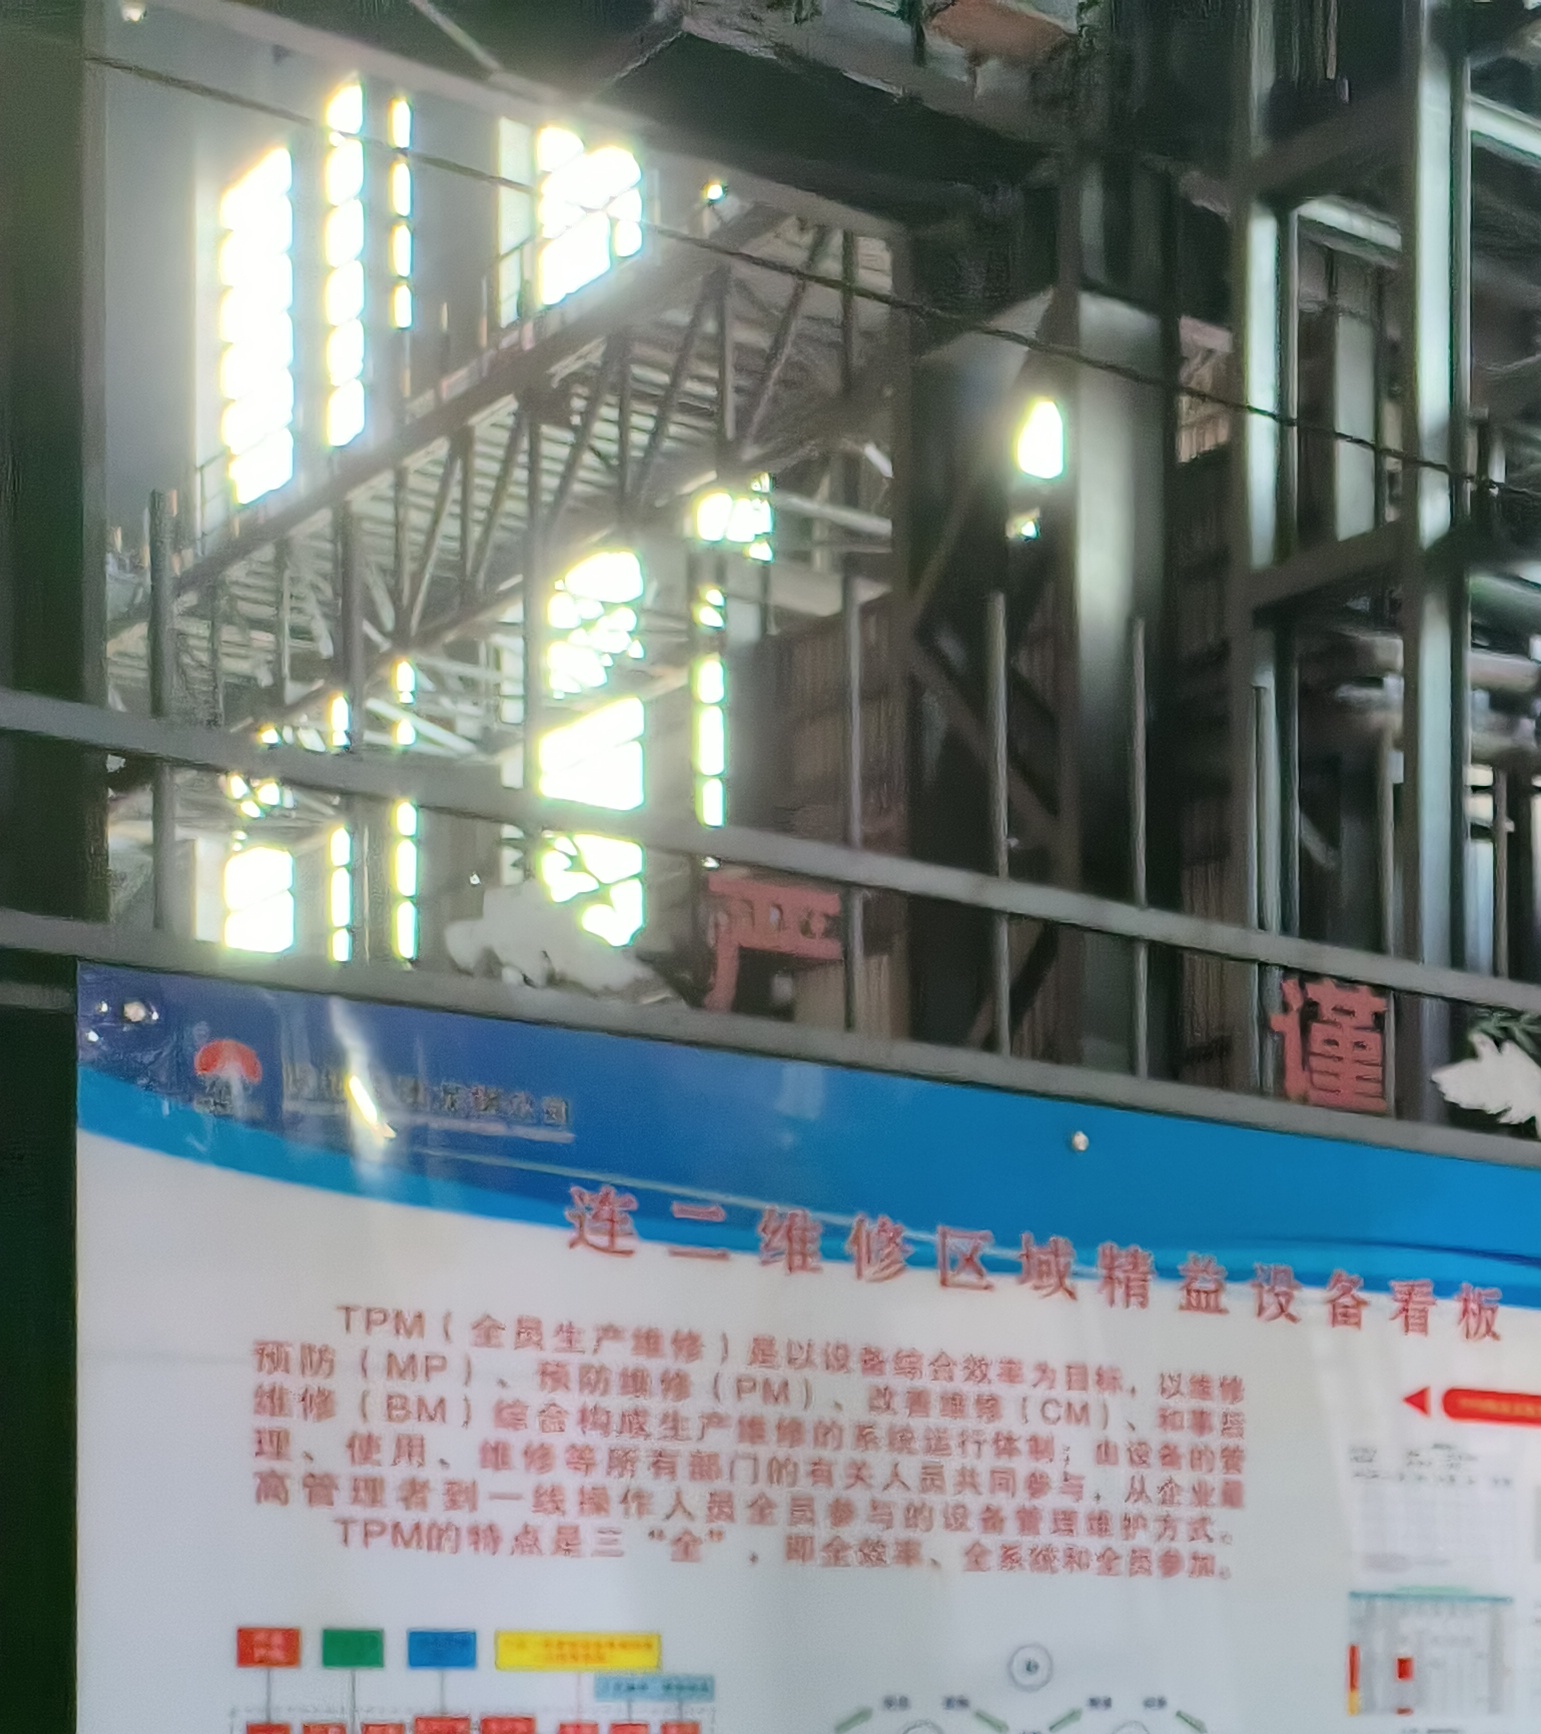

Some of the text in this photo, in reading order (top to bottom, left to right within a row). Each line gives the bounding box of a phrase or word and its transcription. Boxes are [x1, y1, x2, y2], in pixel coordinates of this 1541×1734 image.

[566, 1185, 1503, 1342] 连二维修区域精益设备看板
